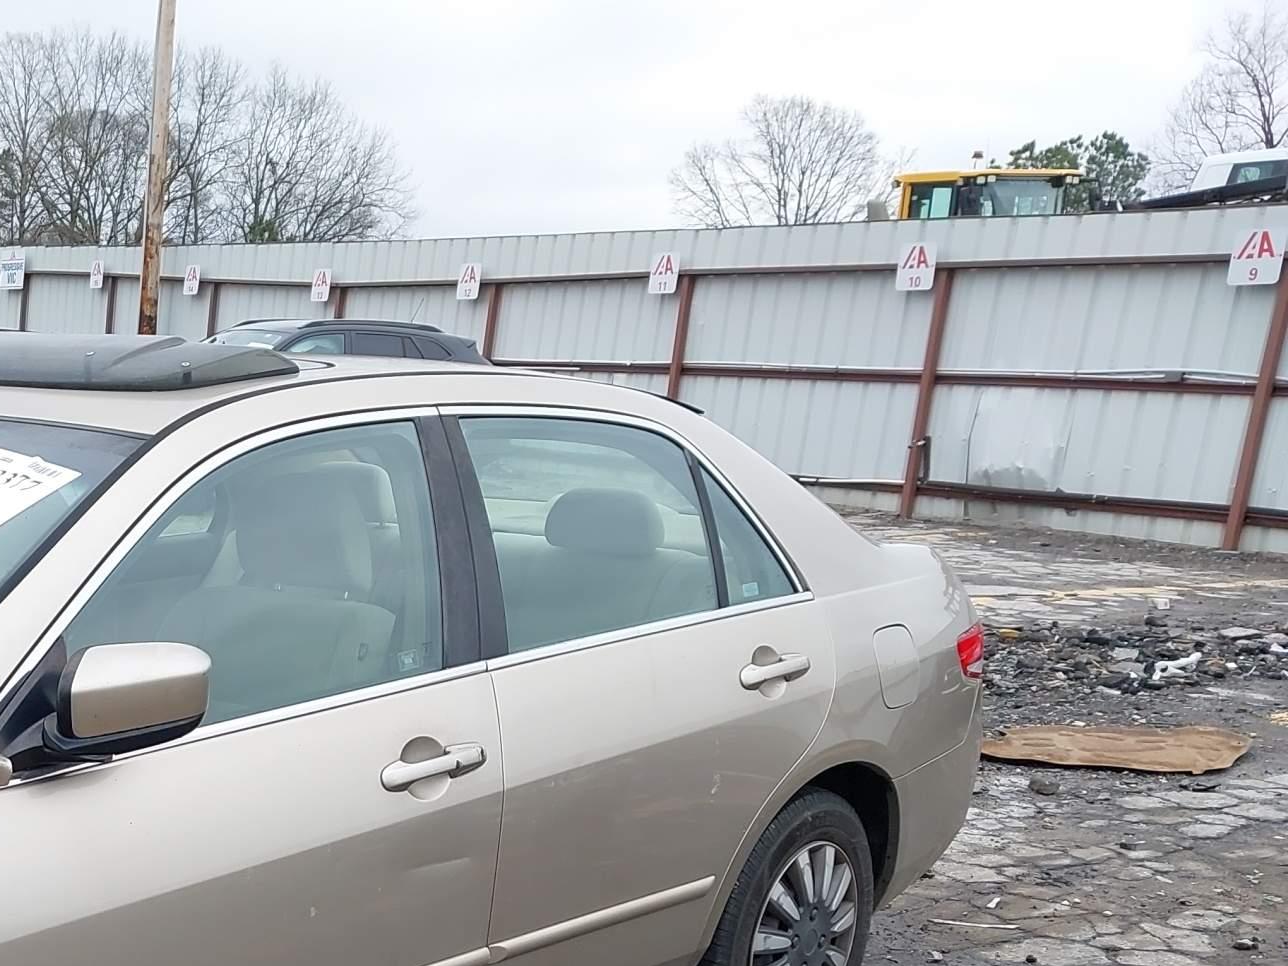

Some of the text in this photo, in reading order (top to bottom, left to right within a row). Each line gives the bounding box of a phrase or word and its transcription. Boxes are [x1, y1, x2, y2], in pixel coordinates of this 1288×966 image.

[1248, 267, 1259, 281] 9
[658, 281, 667, 291] 11
[908, 276, 921, 288] 10
